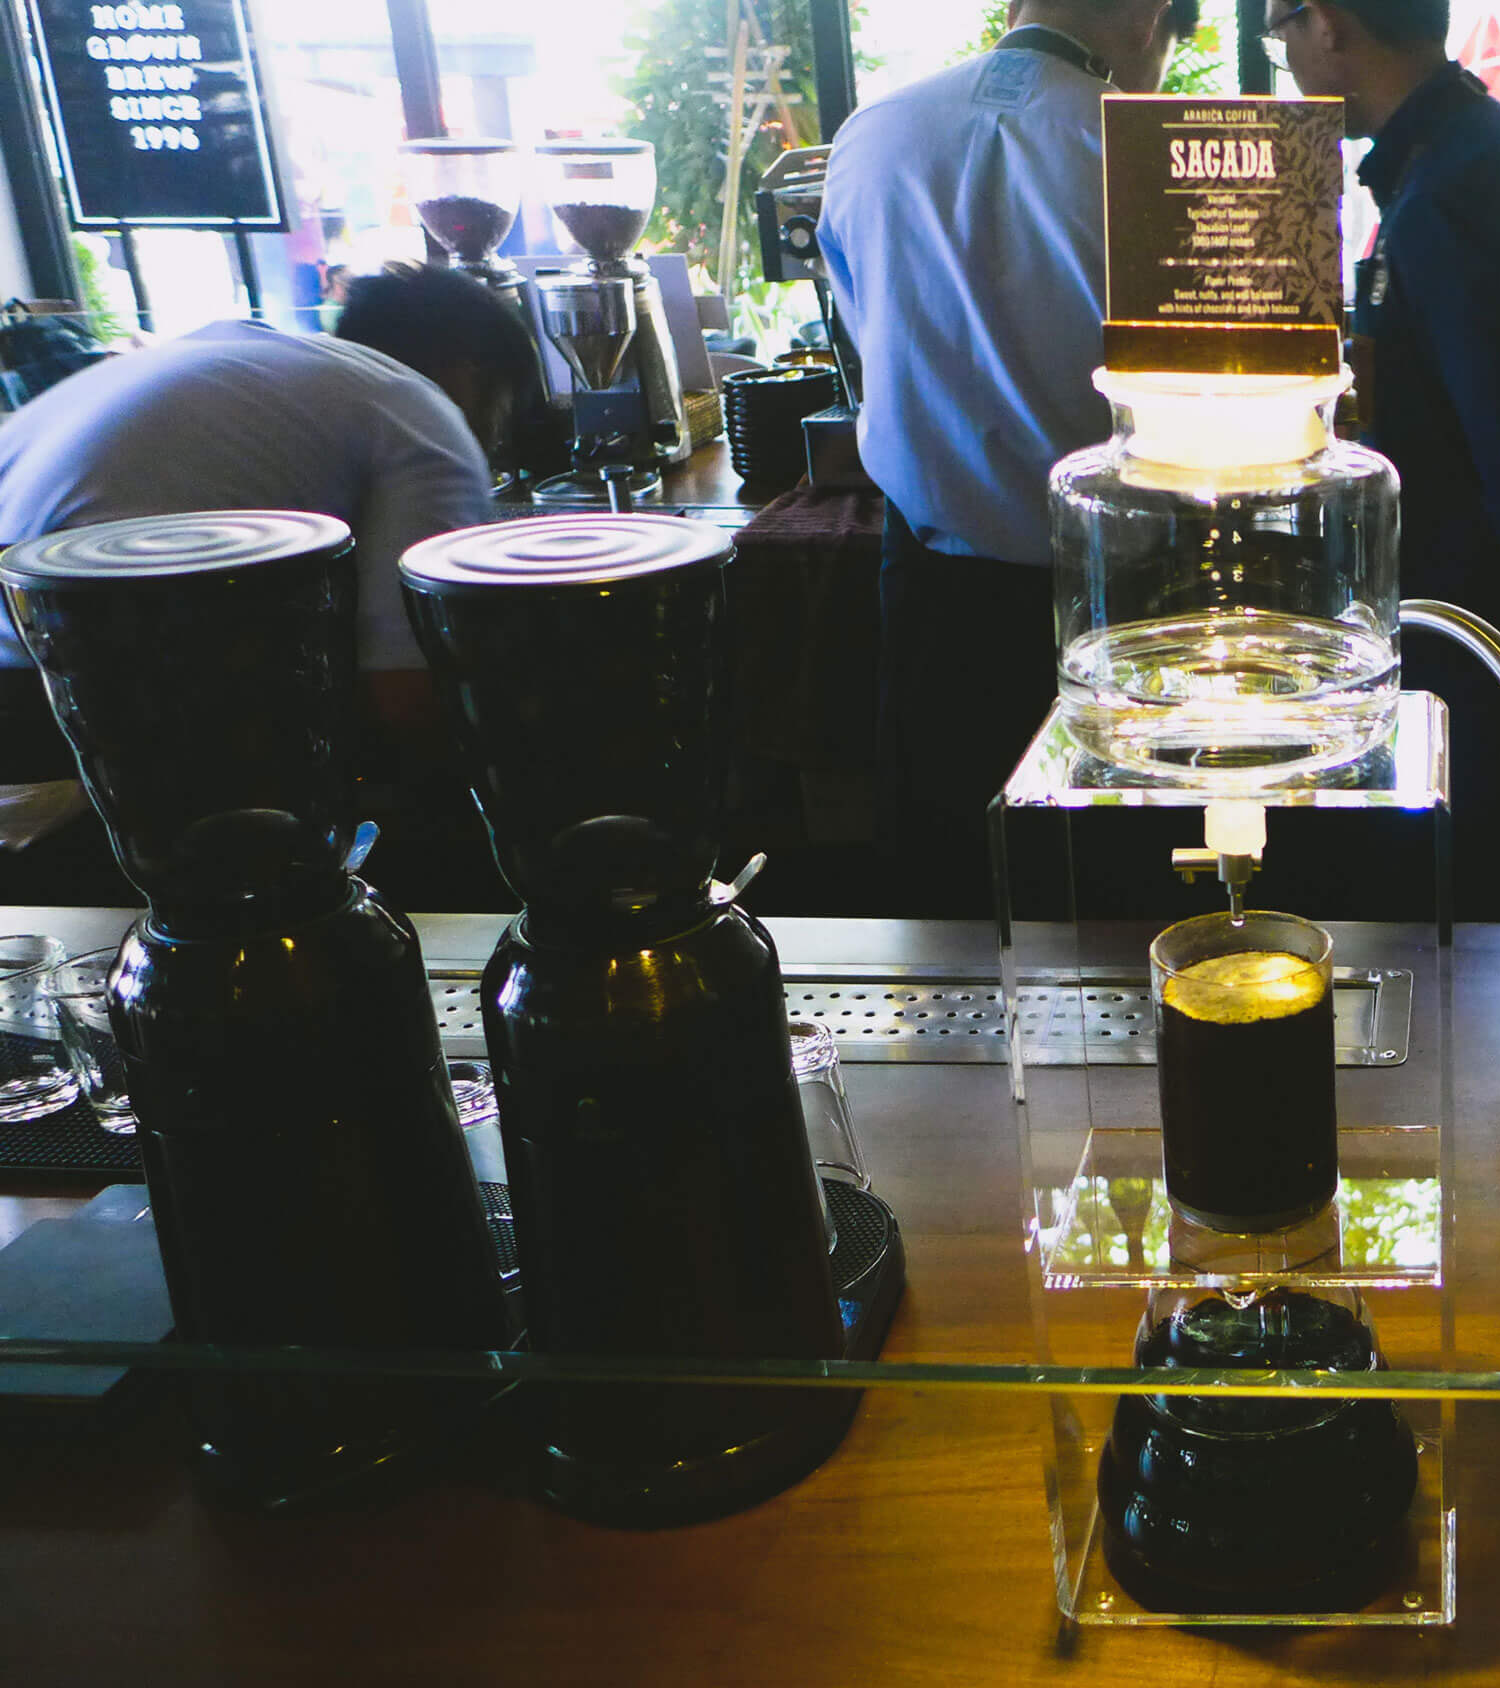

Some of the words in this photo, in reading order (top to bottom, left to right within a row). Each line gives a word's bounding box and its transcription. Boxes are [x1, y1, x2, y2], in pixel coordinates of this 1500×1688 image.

[90, 4, 185, 30] HOME
[86, 34, 202, 62] GROWN
[104, 65, 195, 91] BREW
[109, 95, 203, 121] SINCE
[1183, 109, 1224, 121] ARABICA
[1225, 109, 1257, 121] COFFEE
[129, 125, 201, 151] 1996
[1169, 139, 1276, 178] SAGADA
